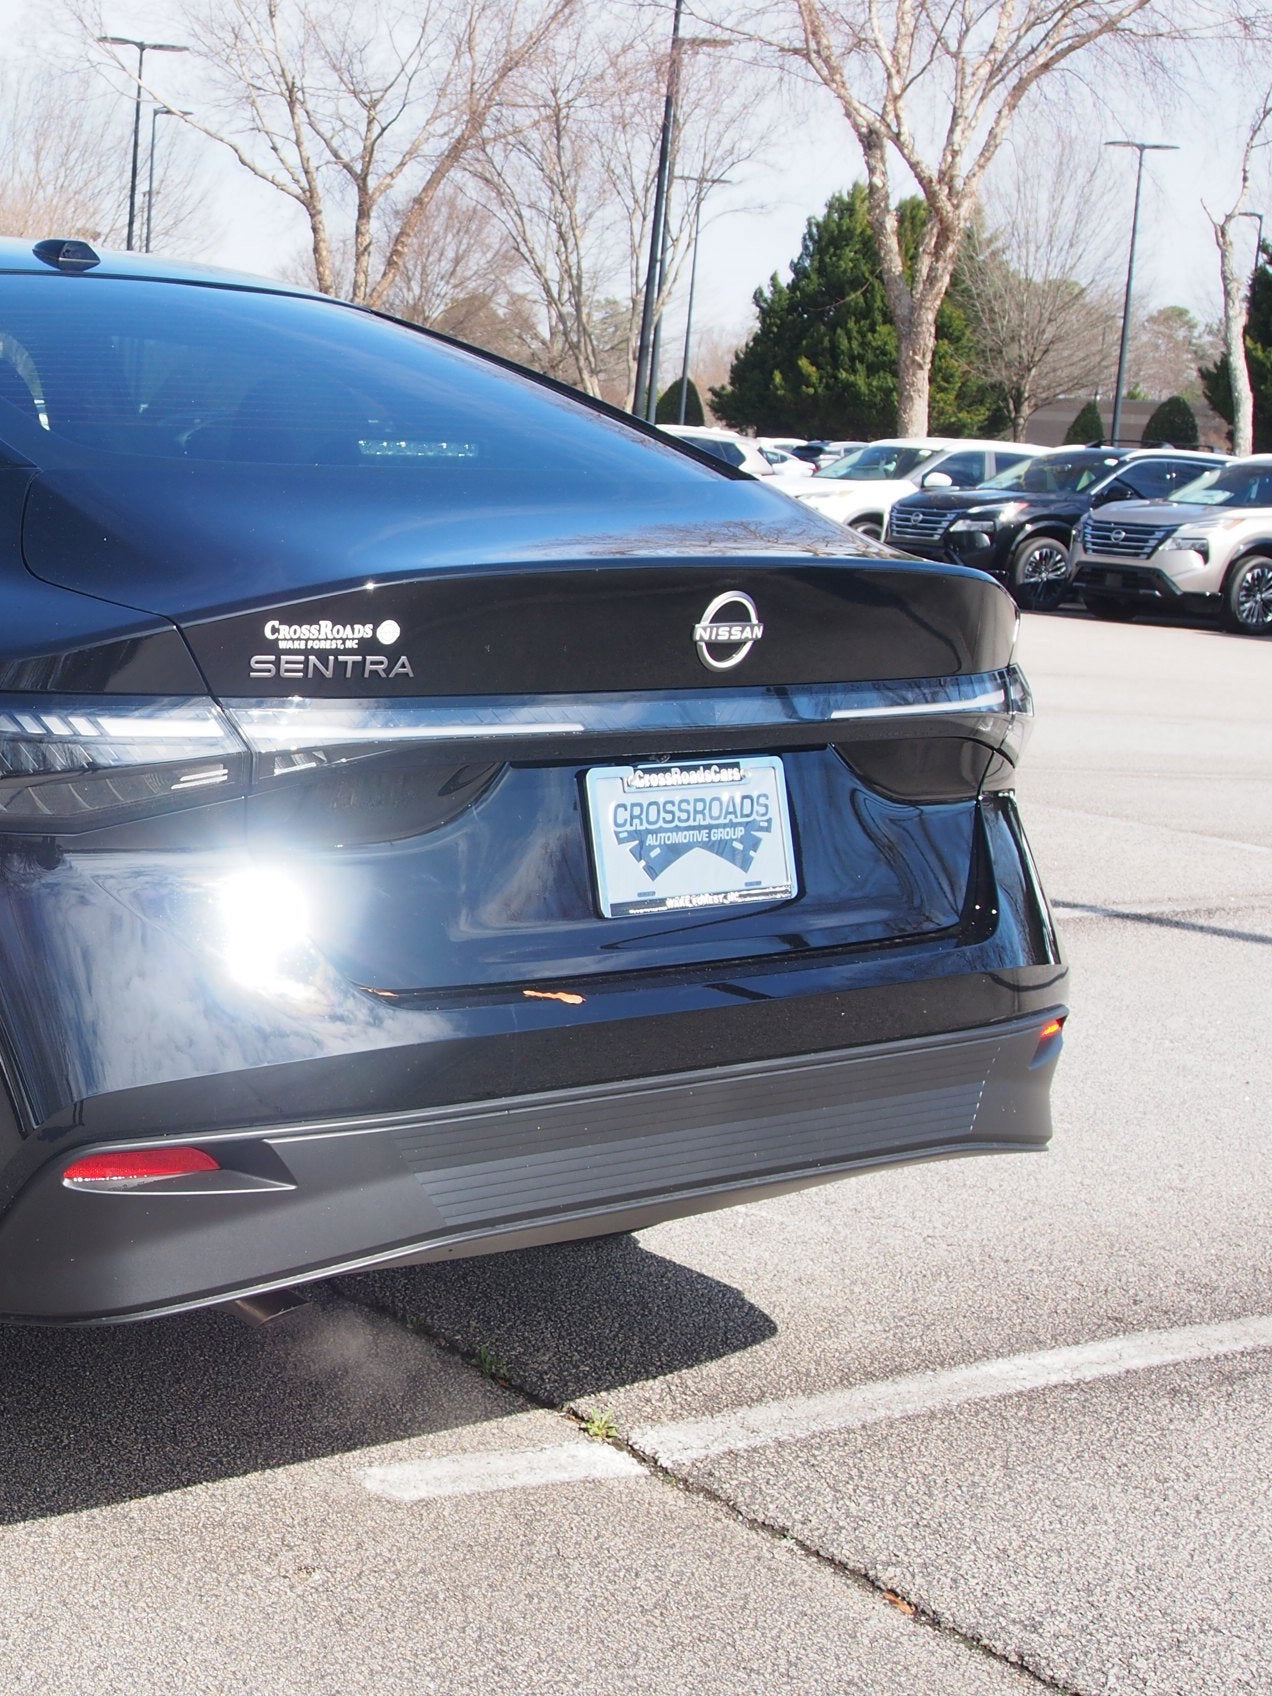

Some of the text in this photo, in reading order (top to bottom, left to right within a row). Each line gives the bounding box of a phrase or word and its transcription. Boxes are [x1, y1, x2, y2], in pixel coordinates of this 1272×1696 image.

[695, 625, 764, 641] NISSAN
[278, 639, 359, 650] WAKE FOREST, NC
[249, 655, 415, 678] SENTRA
[613, 793, 770, 829] CROSSROADS
[646, 827, 745, 846] AUTOMOTIVE GROUP
